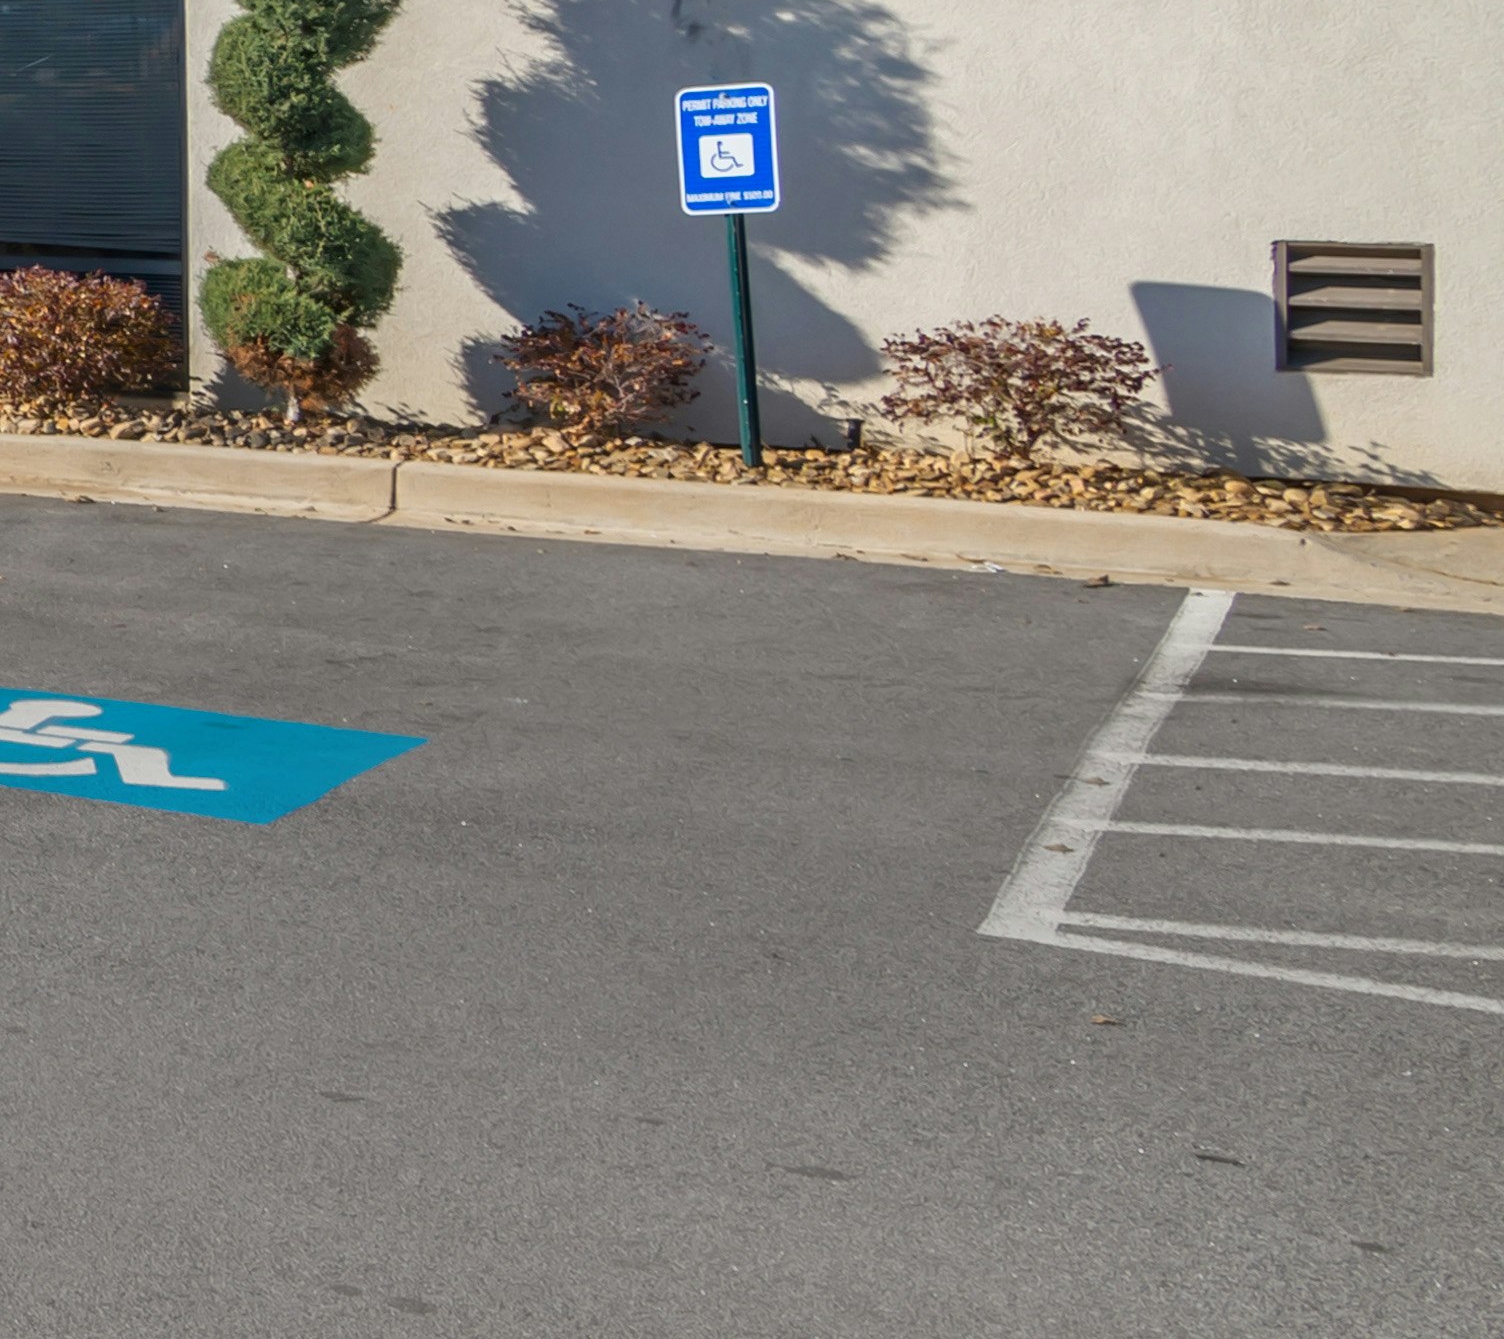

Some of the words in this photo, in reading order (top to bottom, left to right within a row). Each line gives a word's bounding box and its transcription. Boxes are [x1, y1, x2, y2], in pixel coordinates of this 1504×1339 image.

[682, 99, 711, 111] PERMIT
[712, 96, 747, 110] PARKING
[747, 95, 768, 107] ONLY
[693, 114, 735, 127] TOW-AWAY
[736, 112, 758, 124] ZONE
